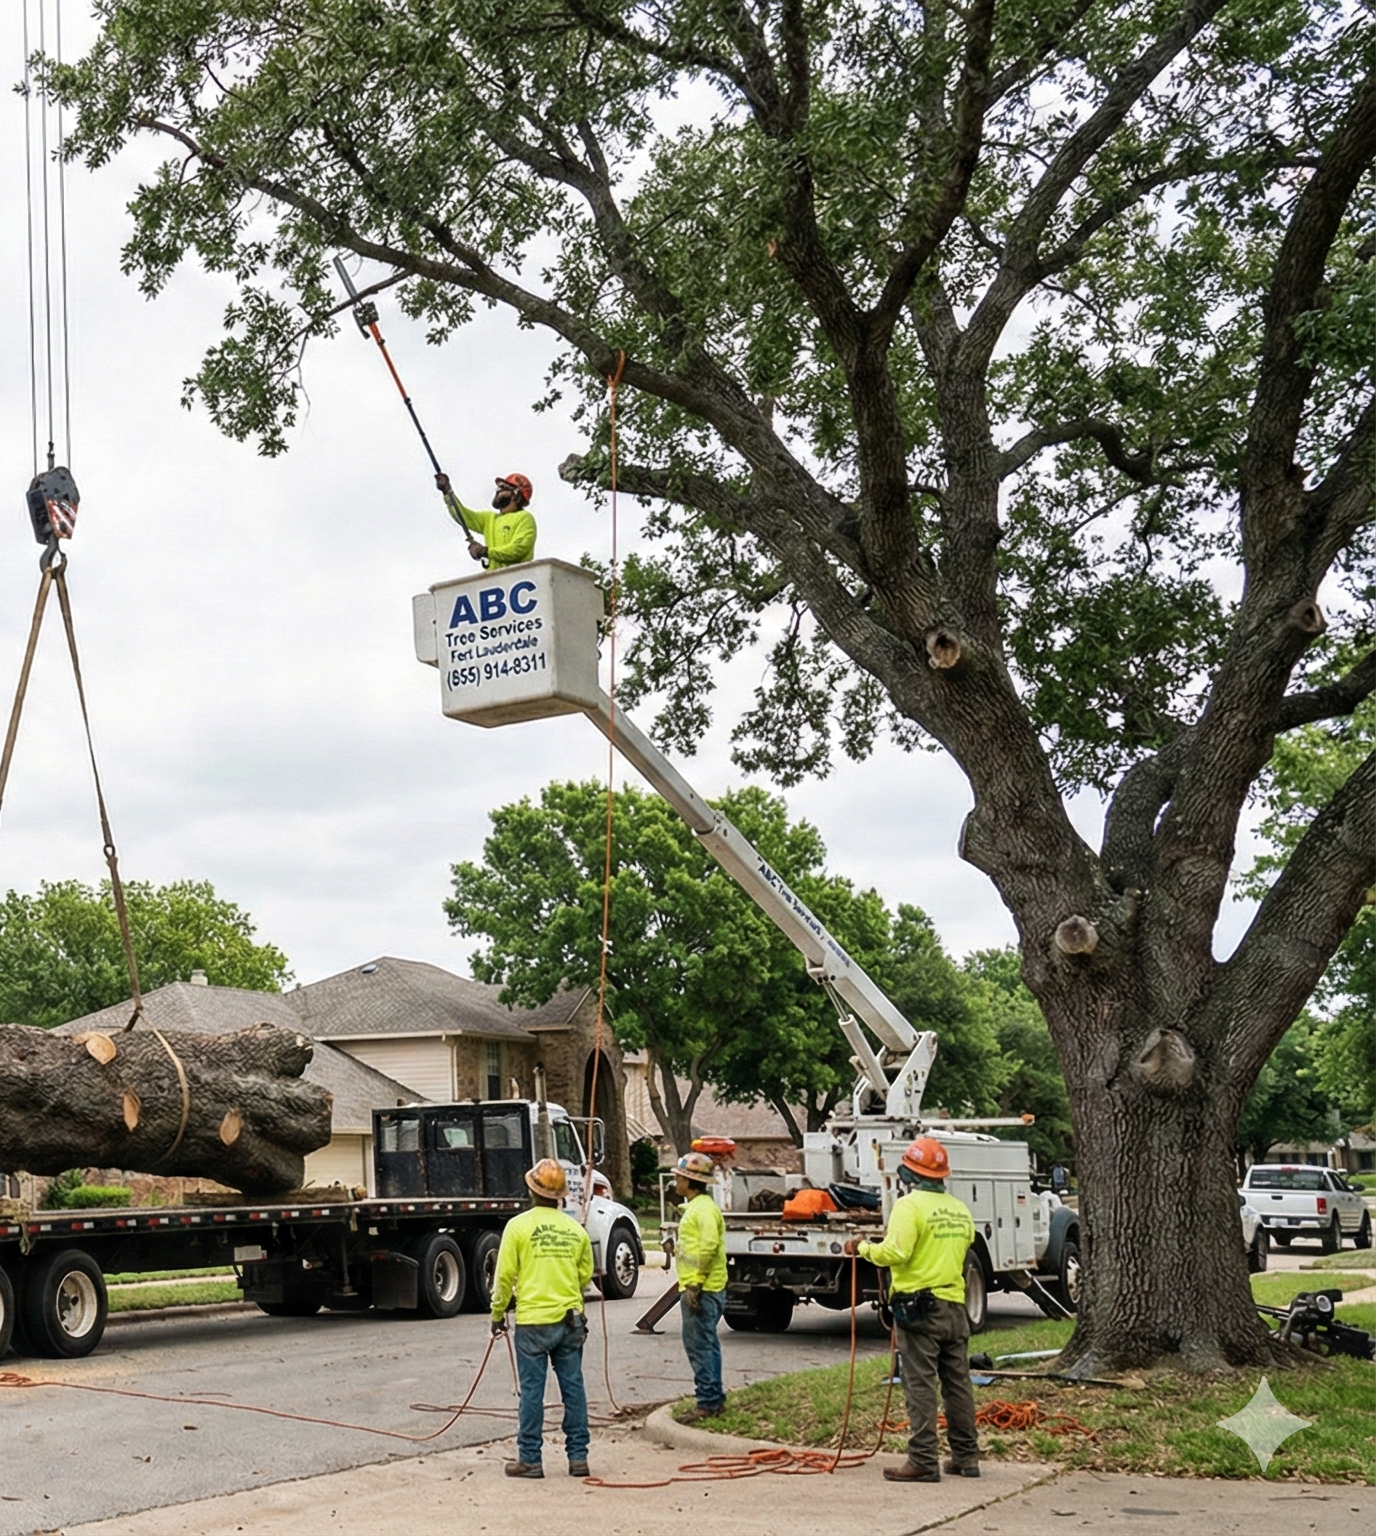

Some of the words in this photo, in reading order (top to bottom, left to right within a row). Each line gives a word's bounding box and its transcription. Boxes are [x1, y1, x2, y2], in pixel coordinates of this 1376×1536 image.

[449, 581, 538, 629] ABC
[446, 632, 475, 647] Tree
[479, 617, 542, 640] Services
[447, 666, 480, 691] (855)
[485, 652, 546, 681] 914-8311
[451, 650, 473, 663] Fort
